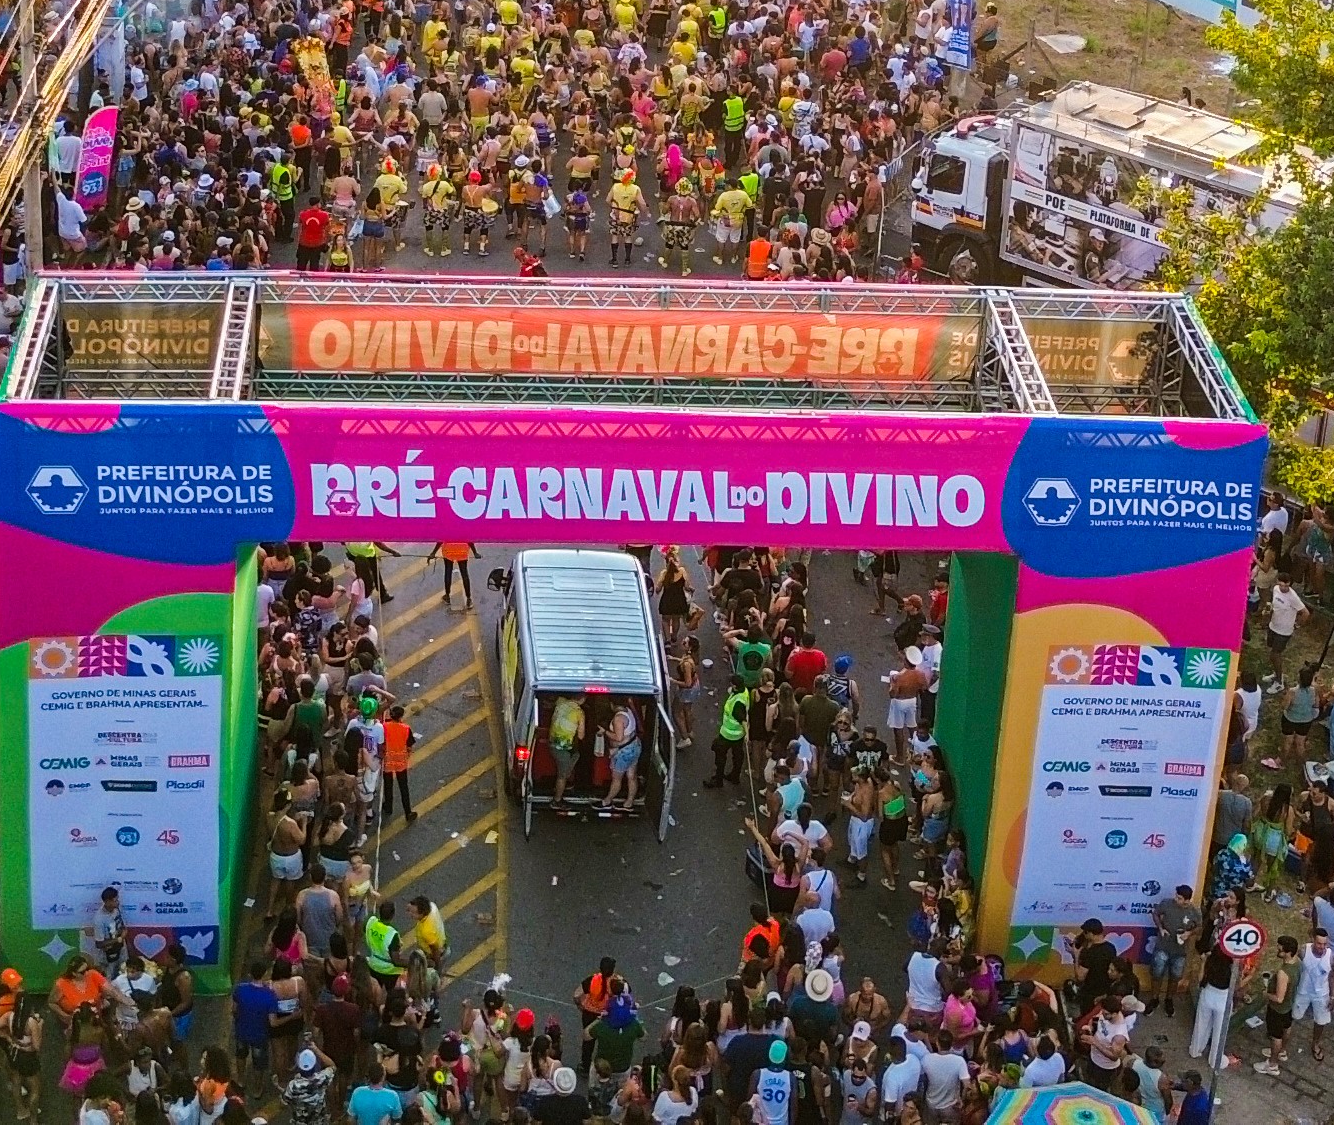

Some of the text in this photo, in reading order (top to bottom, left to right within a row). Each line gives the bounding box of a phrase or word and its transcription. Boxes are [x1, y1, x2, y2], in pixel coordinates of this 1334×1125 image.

[1045, 194, 1066, 211] POE
[1089, 210, 1151, 237] PLATAFORMA DE
[97, 465, 272, 481] PREFEITURA DE
[98, 480, 274, 504] DIVINÓPOLIS
[311, 449, 745, 523] PRÉ-CARNAVAL
[765, 470, 986, 528] DIVINO
[1090, 478, 1253, 498] PREFEITURA DE
[235, 507, 274, 515] MELHOR
[1089, 494, 1253, 521] DIVINÓPOLIS
[1089, 519, 1124, 527] JUNTOS
[1153, 520, 1181, 528] FAZER
[1215, 523, 1253, 532] MELHOR
[51, 689, 197, 700] GOVERNO DE MINAS GERAIS
[40, 702, 75, 711] CEMIG
[86, 700, 131, 709] BRAHMA
[1063, 697, 1202, 708] GOVERNO DE MINAS GERAIS
[1051, 708, 1084, 716] CEMIG
[1094, 709, 1138, 717] BRAHMA
[39, 756, 91, 770] CEMIG
[170, 756, 208, 767] BRAHMA
[1043, 761, 1092, 773] CEMIG
[1166, 763, 1202, 776] BRAHMA
[1159, 786, 1198, 797] Plasdil
[155, 829, 180, 845] 45
[1142, 833, 1166, 848] 45
[1225, 928, 1259, 946] 40
[762, 1088, 786, 1104] 30
